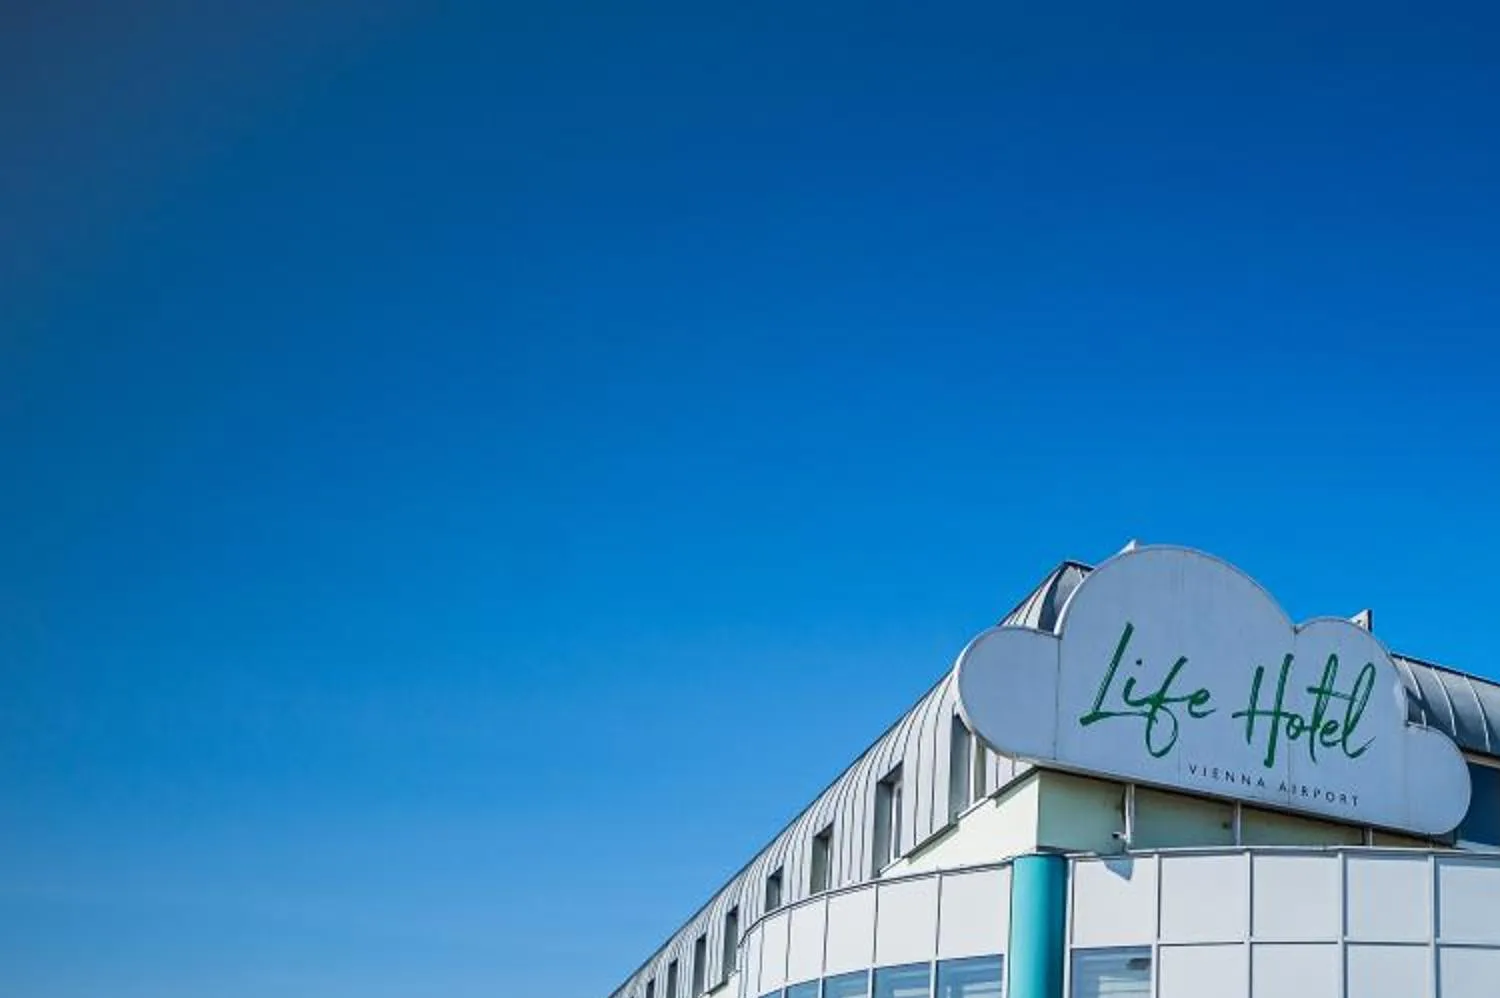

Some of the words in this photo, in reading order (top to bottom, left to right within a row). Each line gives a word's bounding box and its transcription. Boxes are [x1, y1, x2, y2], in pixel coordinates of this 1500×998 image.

[1079, 621, 1217, 758] Life
[1232, 653, 1377, 768] Hotel
[1188, 764, 1266, 788] VIENNA
[1278, 780, 1359, 807] AIRPORT
